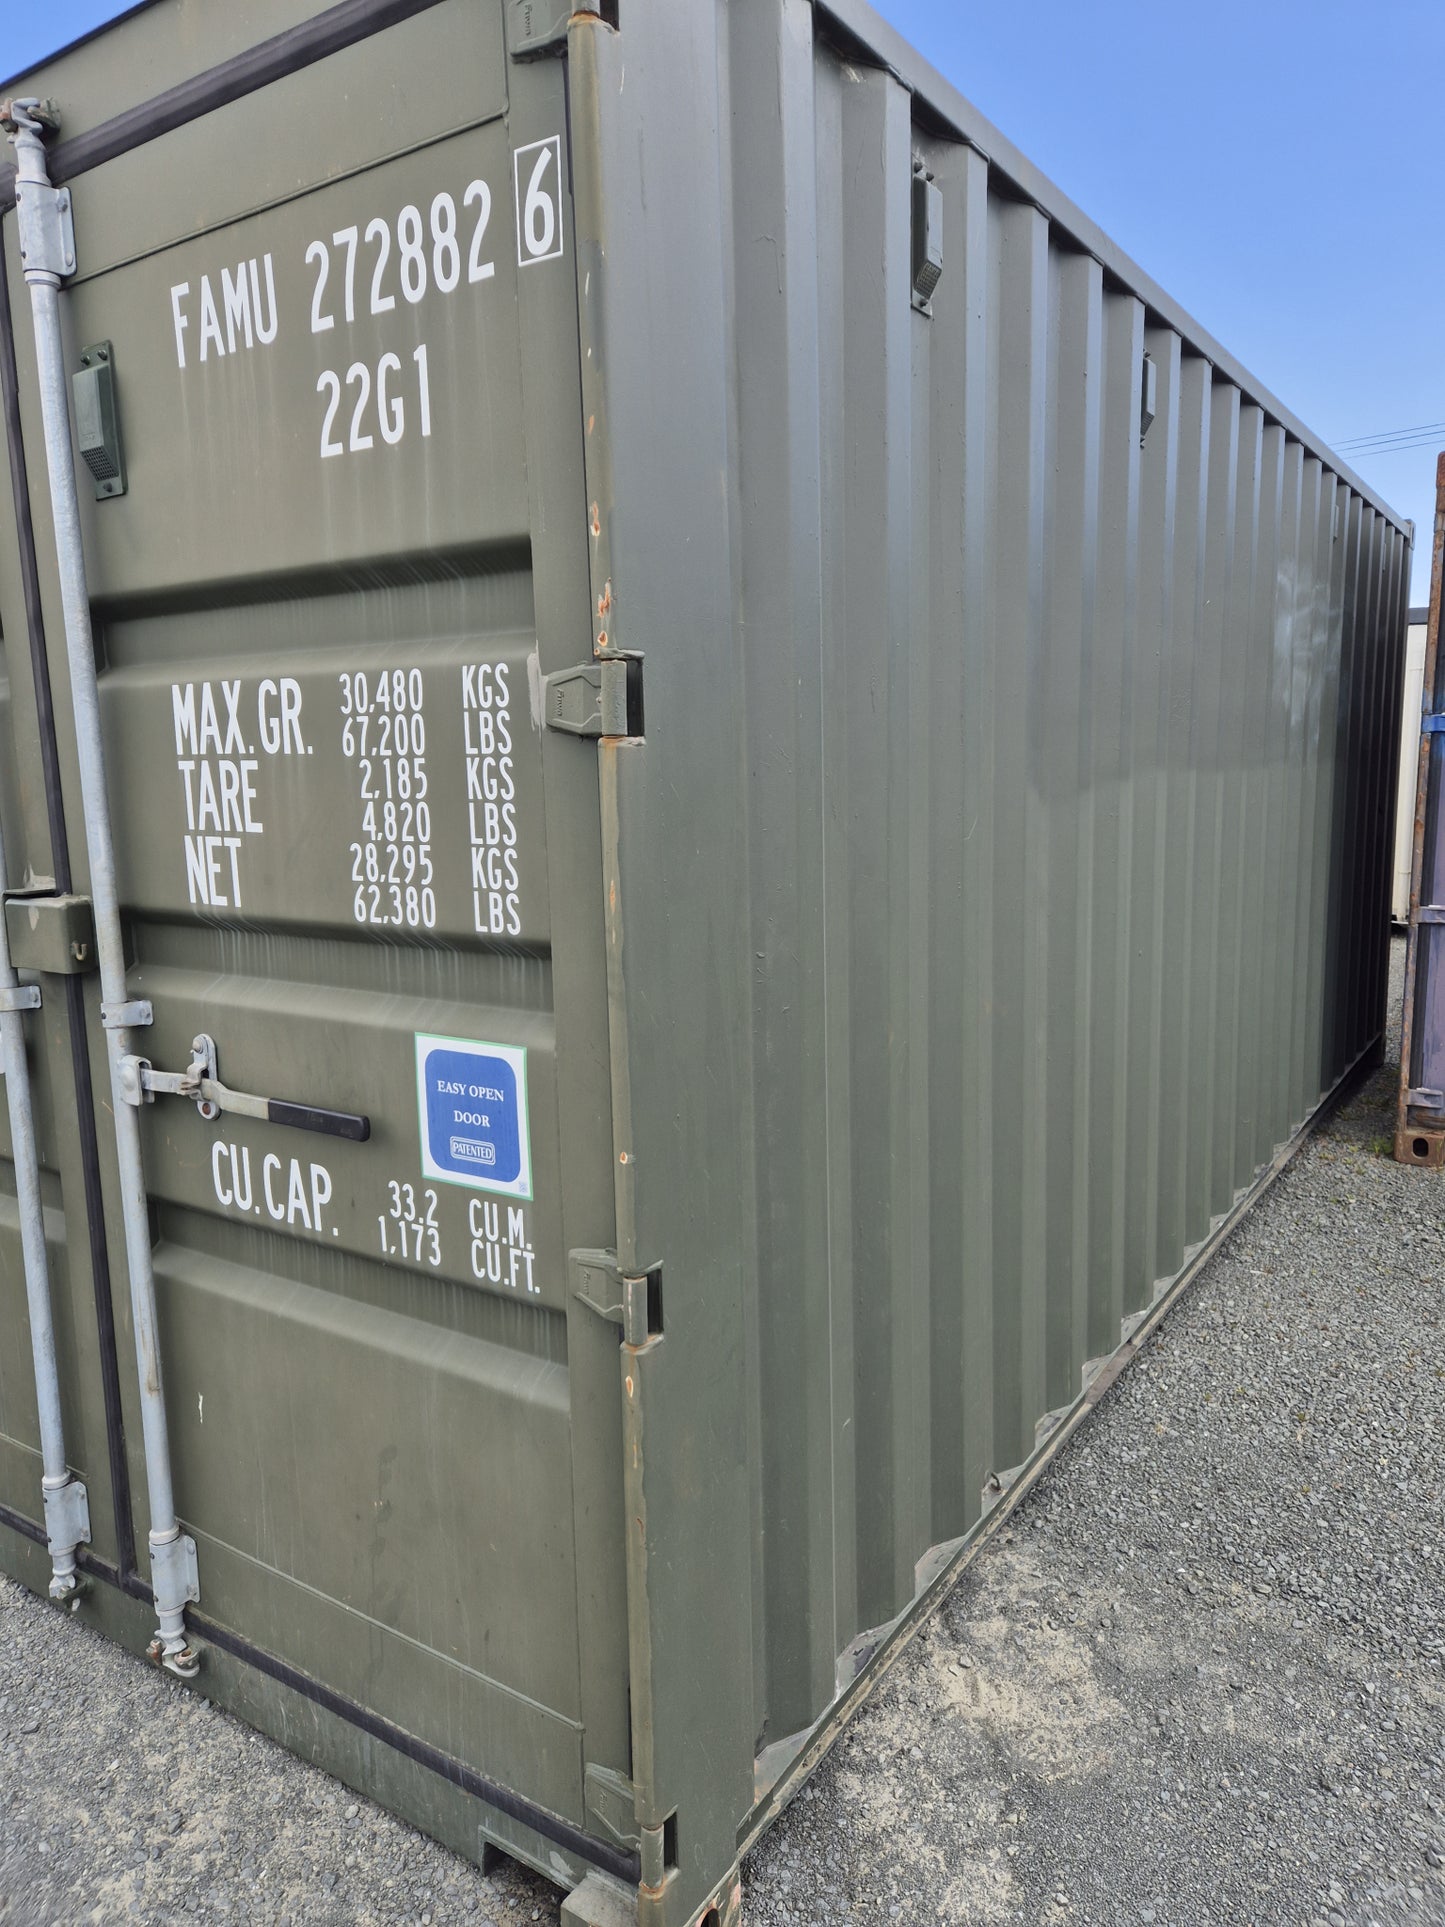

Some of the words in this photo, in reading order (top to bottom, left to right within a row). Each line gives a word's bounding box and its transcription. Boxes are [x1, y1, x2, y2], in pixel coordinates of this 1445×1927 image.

[170, 252, 278, 369] FAMU
[304, 179, 495, 334] 272882
[524, 146, 556, 257] 6
[316, 343, 432, 459] 22G1
[338, 667, 424, 715] 30,480
[461, 662, 510, 709] KGS
[342, 712, 426, 757] 67,200
[463, 709, 513, 755] LBS
[177, 759, 264, 833] TARE
[358, 757, 428, 800] 2,185
[466, 756, 516, 801] KGS
[362, 800, 431, 843] 4,820
[468, 802, 518, 846] LBS
[183, 834, 242, 908] NET
[349, 842, 434, 886] 28,295
[471, 847, 519, 891] KGS
[353, 884, 436, 929] 62,380
[473, 890, 522, 936] LBS
[437, 1080, 466, 1096] EASY
[469, 1085, 504, 1102] OPEN
[453, 1110, 490, 1128] DOOR
[453, 1142, 492, 1160] PATENTED
[388, 1180, 439, 1228] 33.2
[469, 1198, 532, 1251] CU.M.
[378, 1215, 441, 1266] 1,173
[471, 1238, 541, 1294] CU.FT.
